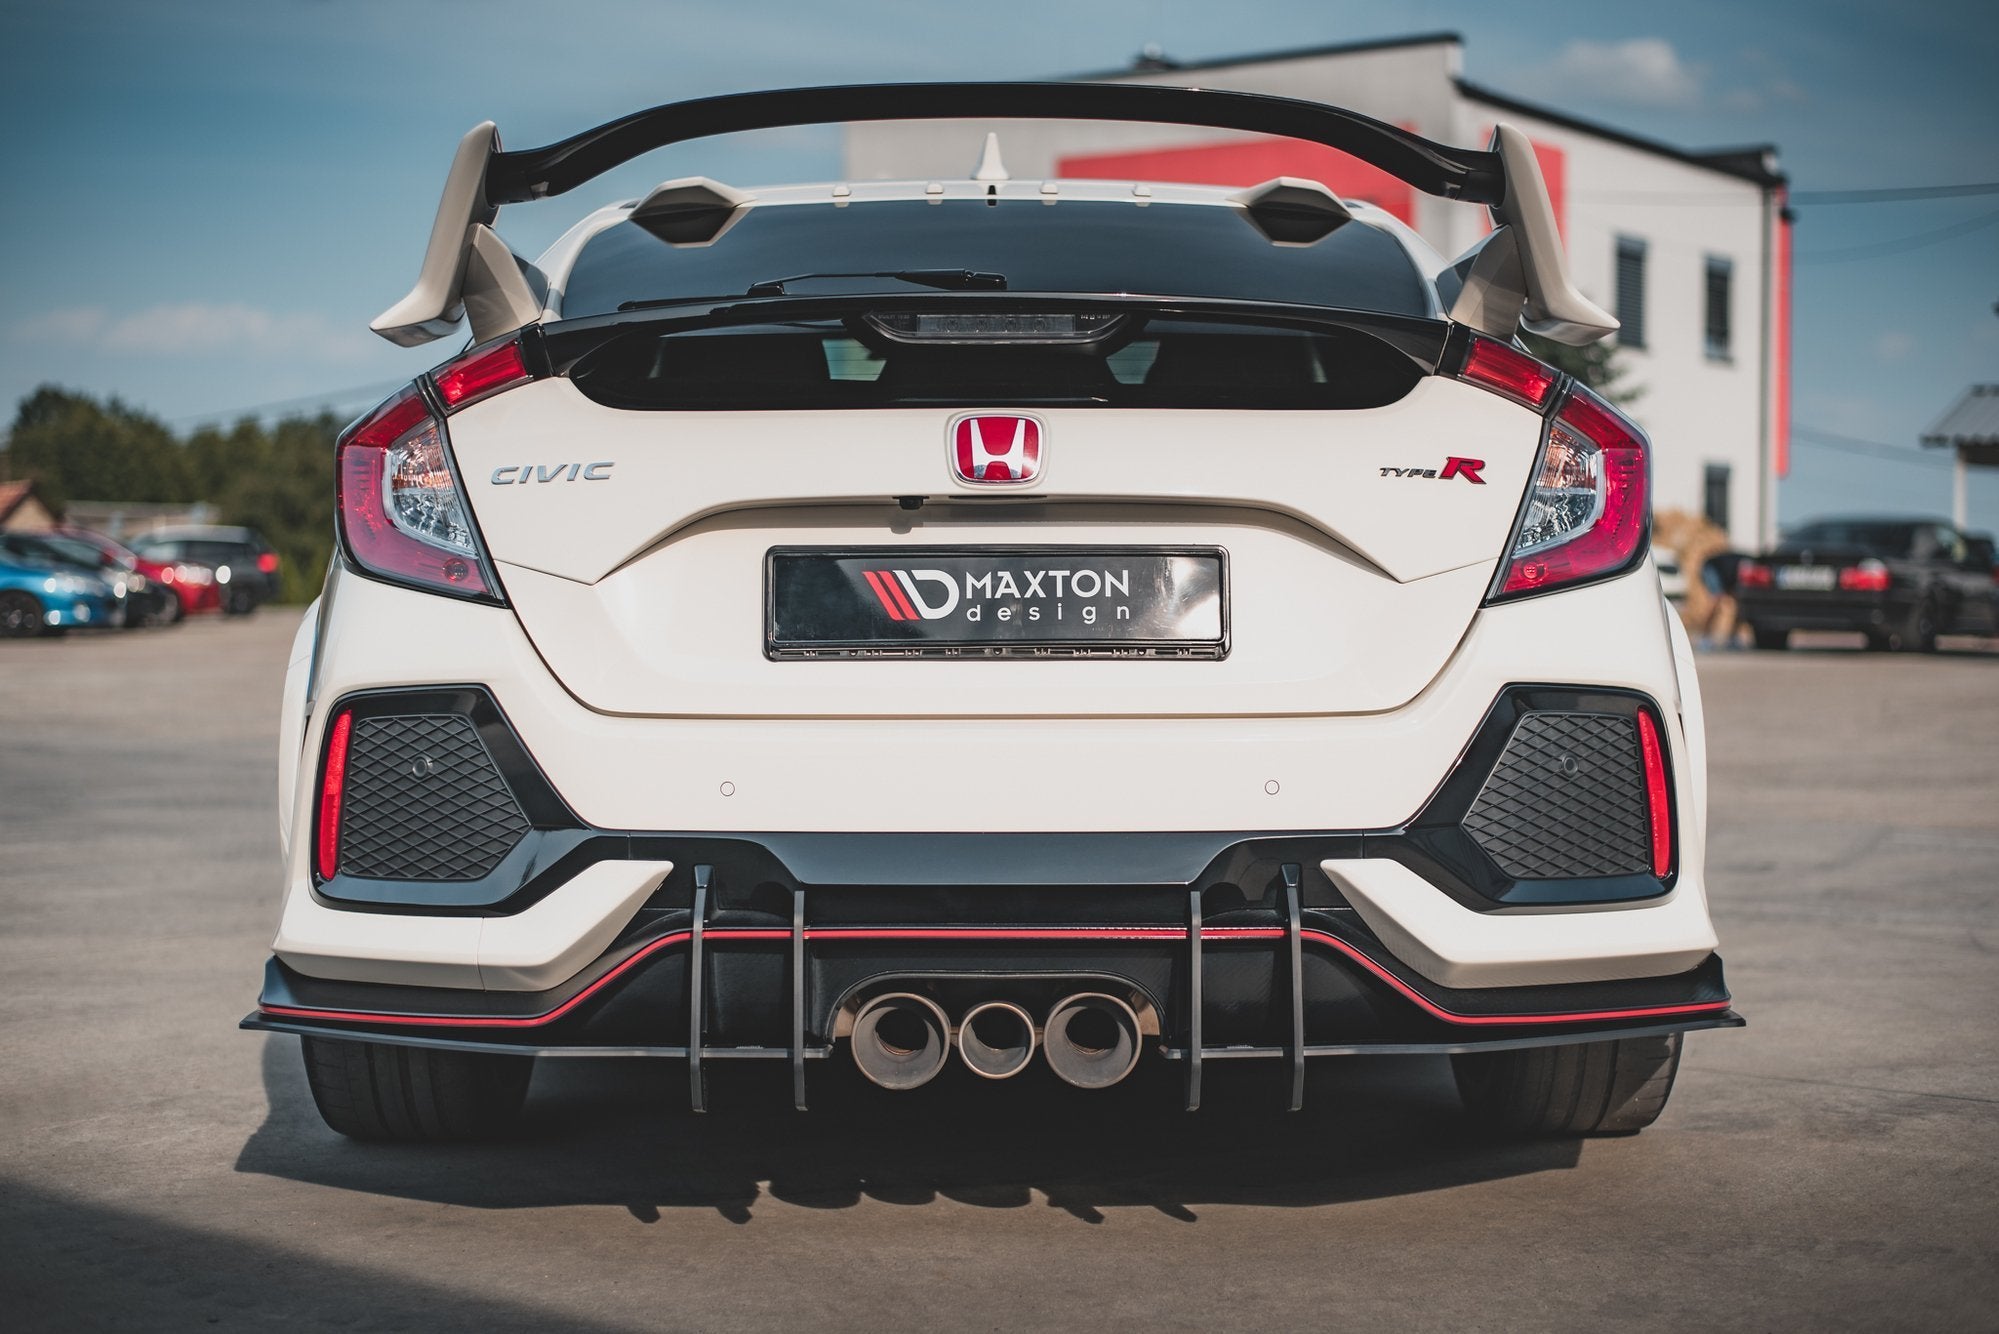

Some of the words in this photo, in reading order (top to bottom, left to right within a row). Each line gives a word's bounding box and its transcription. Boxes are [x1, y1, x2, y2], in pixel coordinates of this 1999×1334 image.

[491, 460, 615, 485] CIVIC
[1380, 467, 1437, 478] TYPE
[1438, 456, 1487, 484] R
[966, 569, 1130, 599] MAXTON
[966, 603, 1130, 625] design
